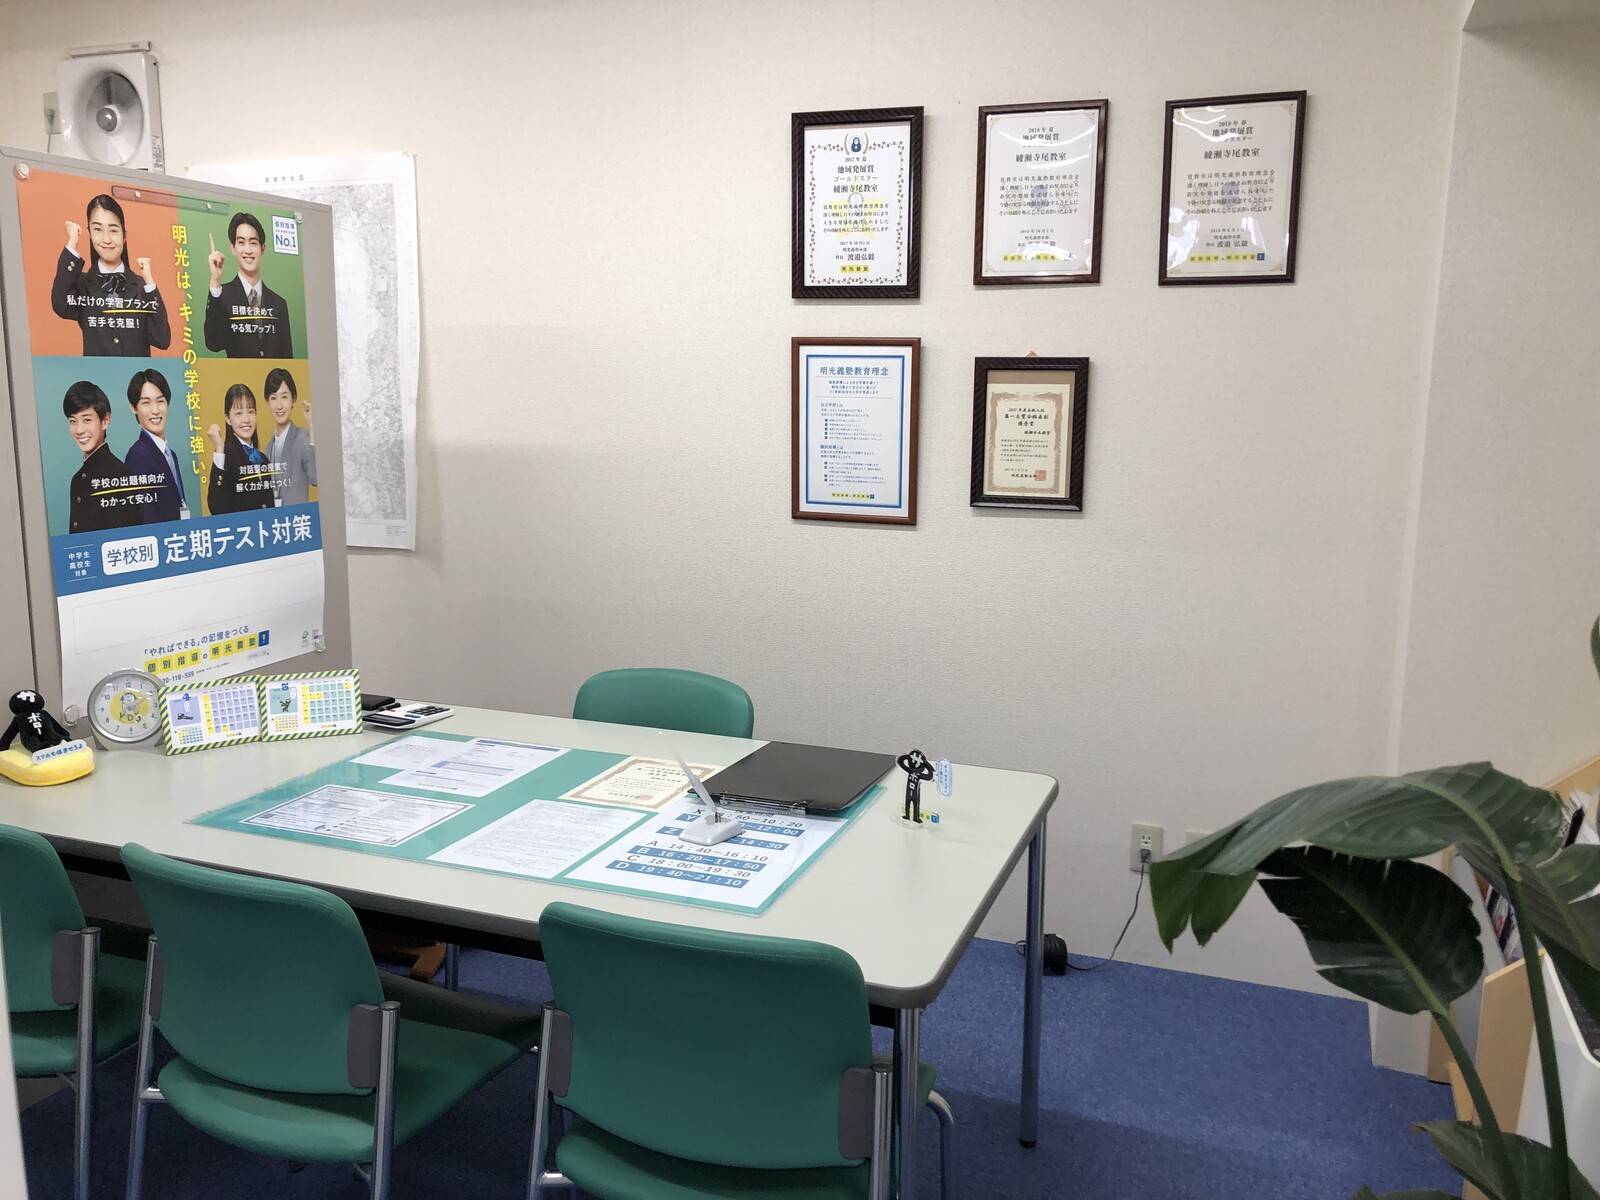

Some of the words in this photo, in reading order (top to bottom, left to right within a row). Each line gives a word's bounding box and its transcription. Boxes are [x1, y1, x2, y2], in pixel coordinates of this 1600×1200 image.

[275, 233, 297, 248] No.1
[66, 294, 159, 310] 私だけの学習プランで
[231, 305, 274, 317] 目標を決めて
[87, 316, 140, 329] 苦手を克服!
[230, 322, 275, 334] やる気アップ!
[172, 224, 208, 485] 明光は、キミの学校に強い。
[820, 366, 889, 377] 明光義塾教育理念
[91, 472, 165, 490] 学校の出題傾向が
[100, 493, 158, 508] わかって安心!
[165, 514, 312, 564] 定期テスト対策
[68, 551, 91, 560] 中学生
[107, 544, 153, 567] 学校別
[69, 560, 92, 569] 高校生
[144, 625, 249, 656] 「やればできる」の記憶をつくる
